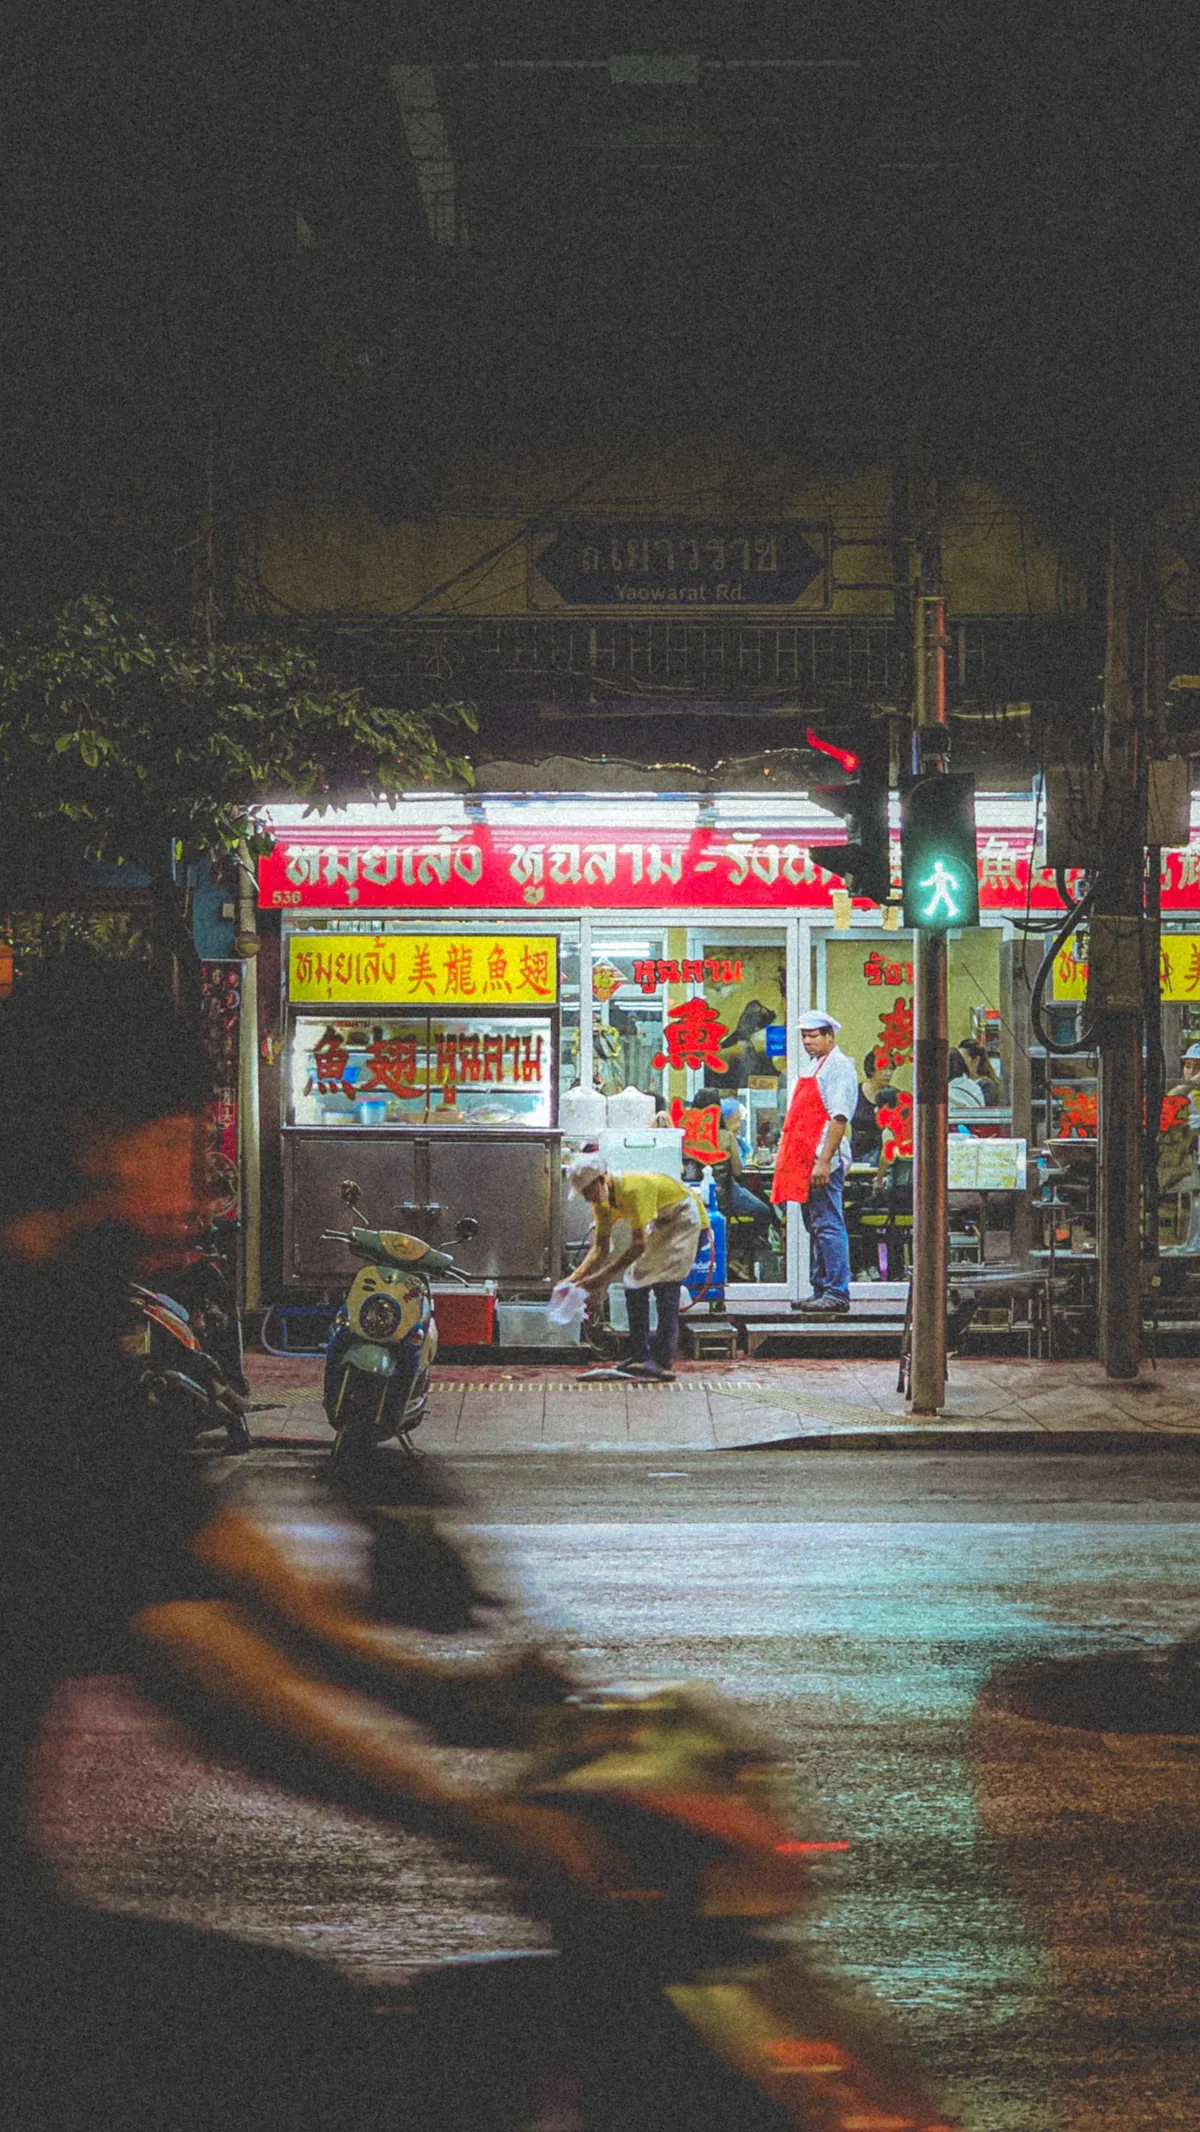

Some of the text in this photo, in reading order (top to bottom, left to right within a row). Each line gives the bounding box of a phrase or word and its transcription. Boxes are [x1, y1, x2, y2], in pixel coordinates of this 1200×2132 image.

[616, 584, 705, 601] Yaowarat
[272, 890, 302, 904] 536
[407, 943, 552, 997] 美龍魚翅
[303, 1026, 428, 1101] 魚翅
